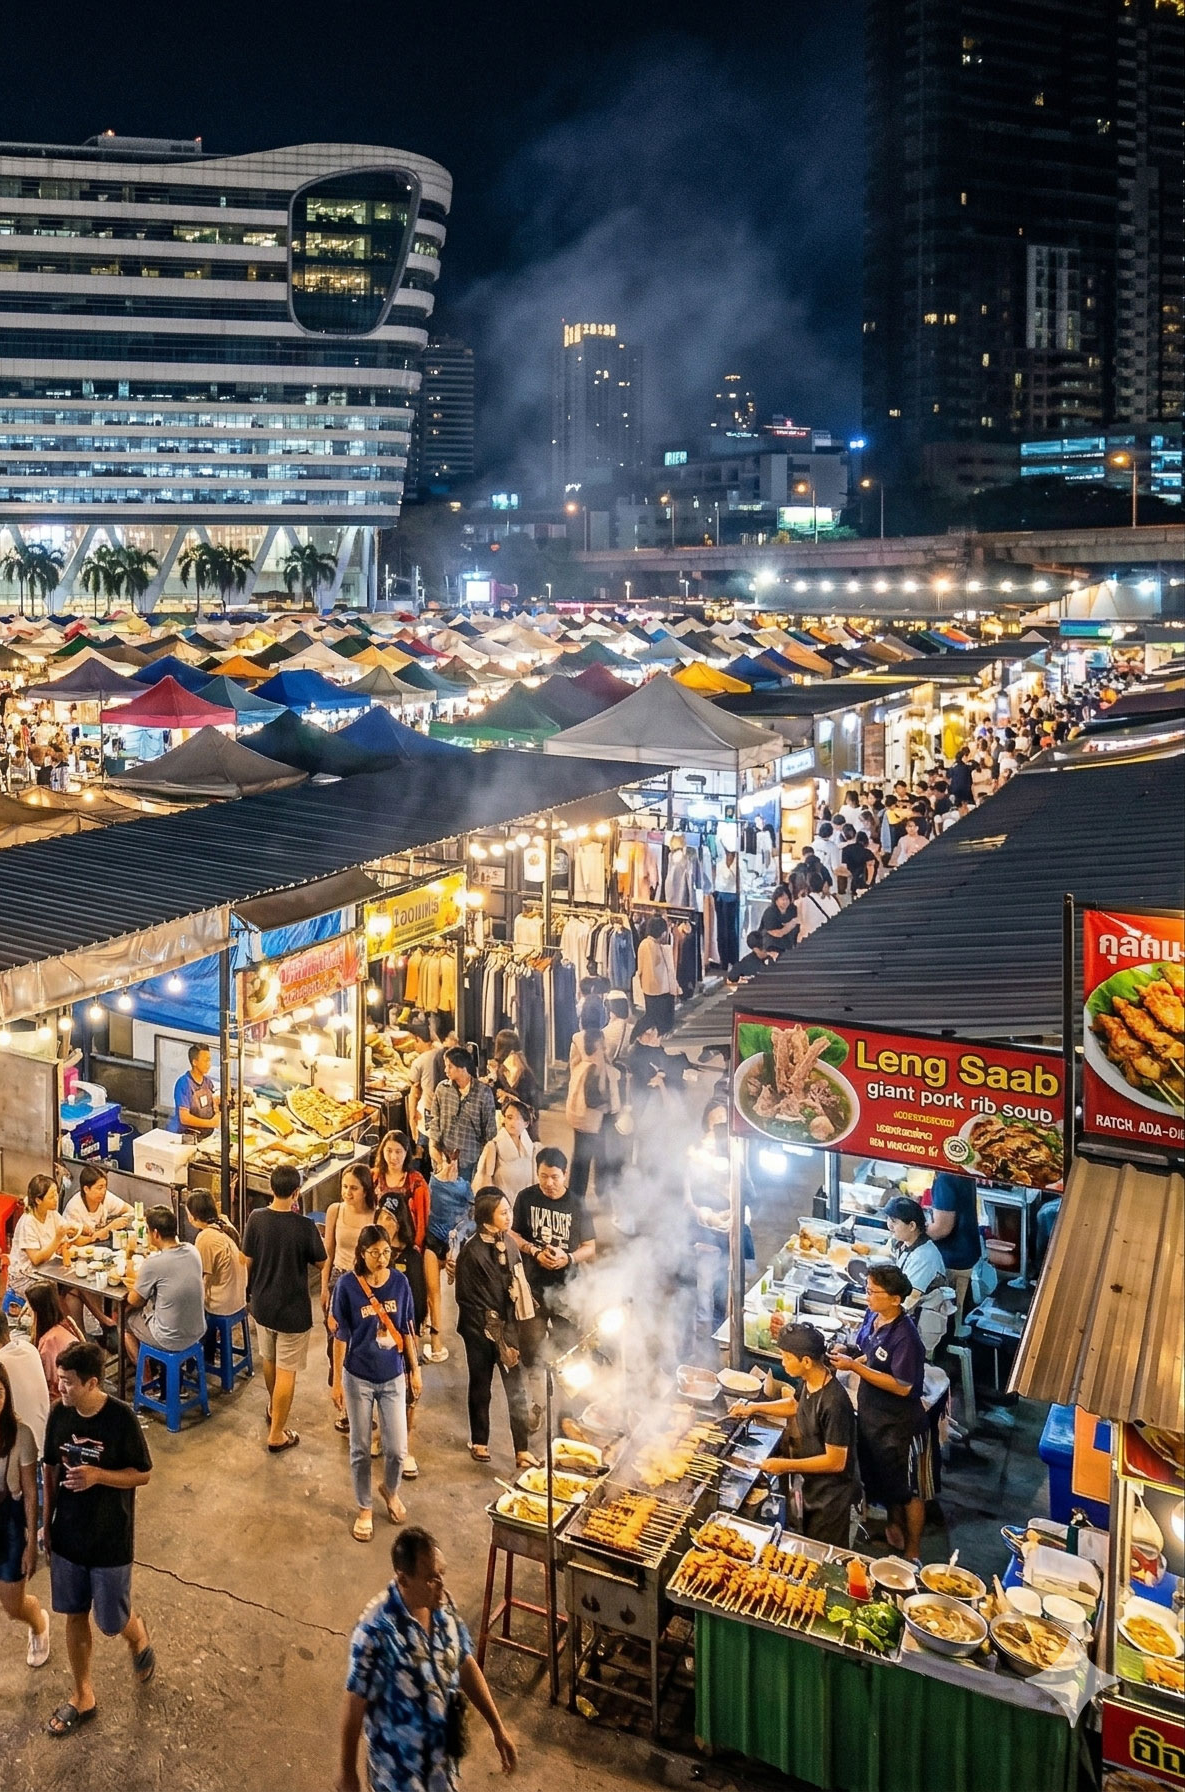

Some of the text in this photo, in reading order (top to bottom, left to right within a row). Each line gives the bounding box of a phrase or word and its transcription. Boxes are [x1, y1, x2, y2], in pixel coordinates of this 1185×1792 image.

[856, 1041, 1059, 1096] Leng Saab
[867, 1081, 915, 1100] giant
[920, 1091, 965, 1109] pork
[971, 1097, 996, 1114] rib
